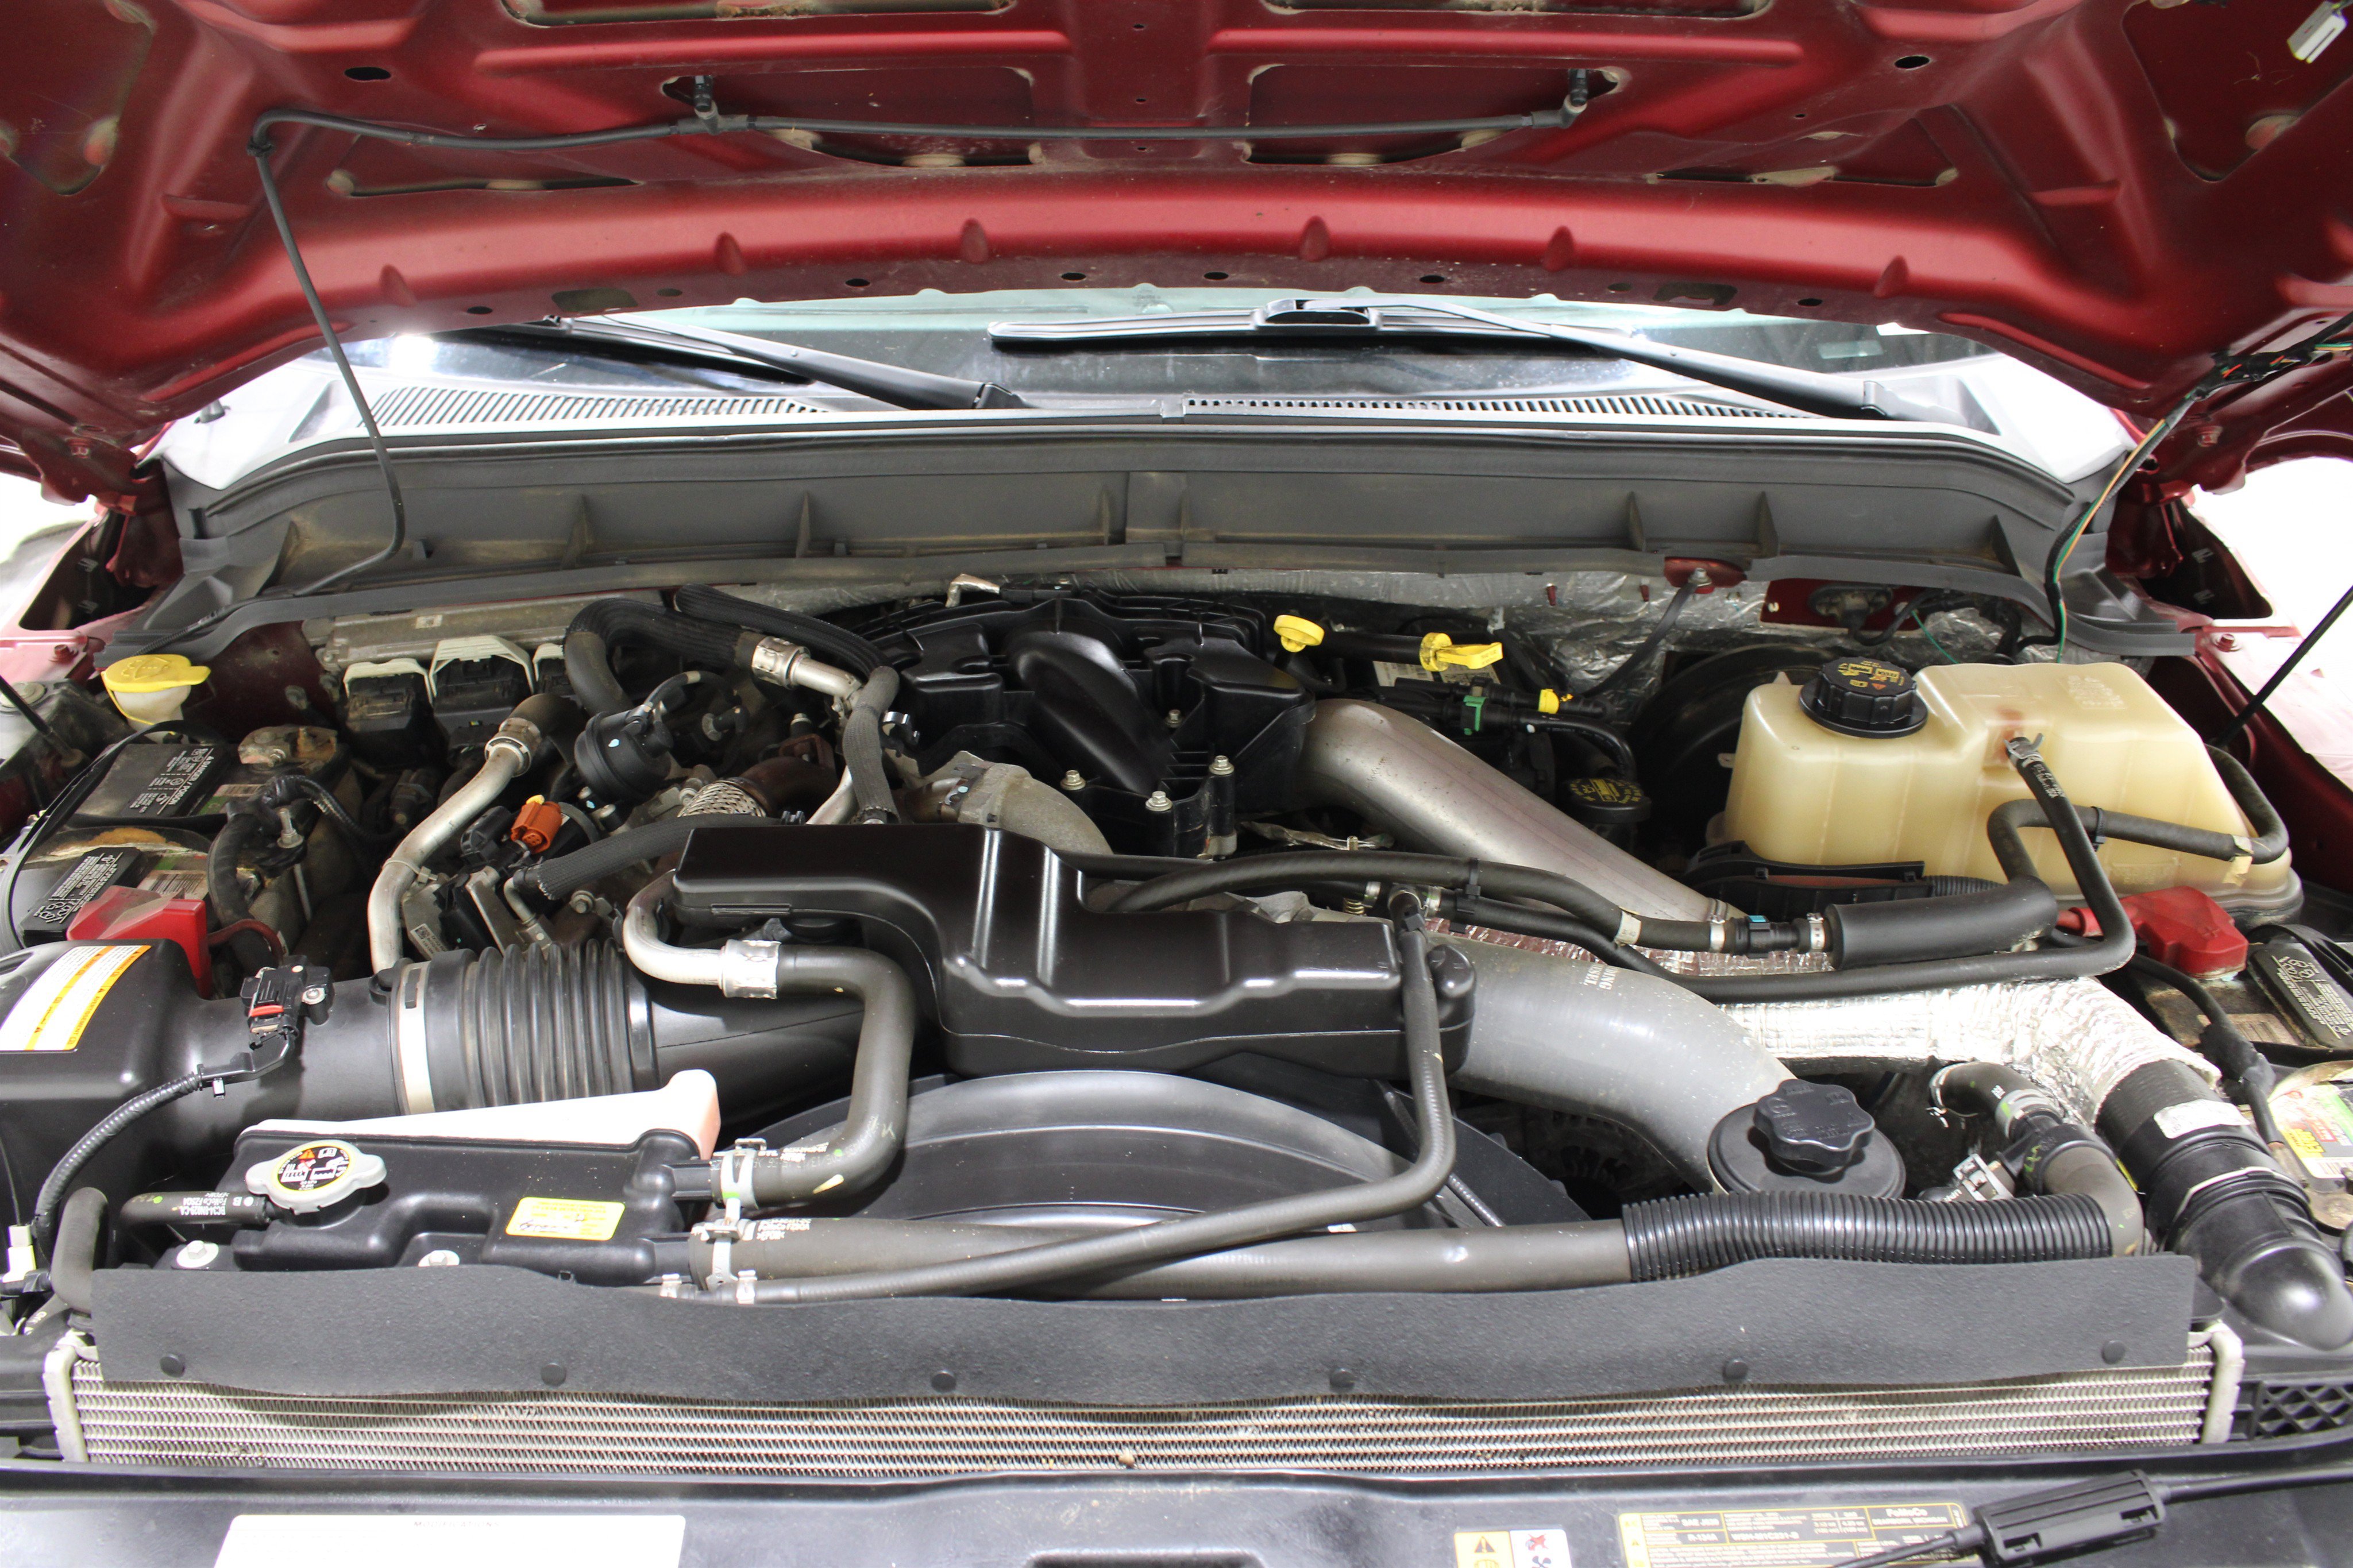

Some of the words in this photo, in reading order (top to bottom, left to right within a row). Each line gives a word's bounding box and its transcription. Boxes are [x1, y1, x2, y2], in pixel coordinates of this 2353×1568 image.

[189, 761, 211, 782] DANGER
[168, 785, 191, 805] POISON
[233, 1196, 242, 1206] B
[1885, 1507, 1928, 1517] FoMoCo
